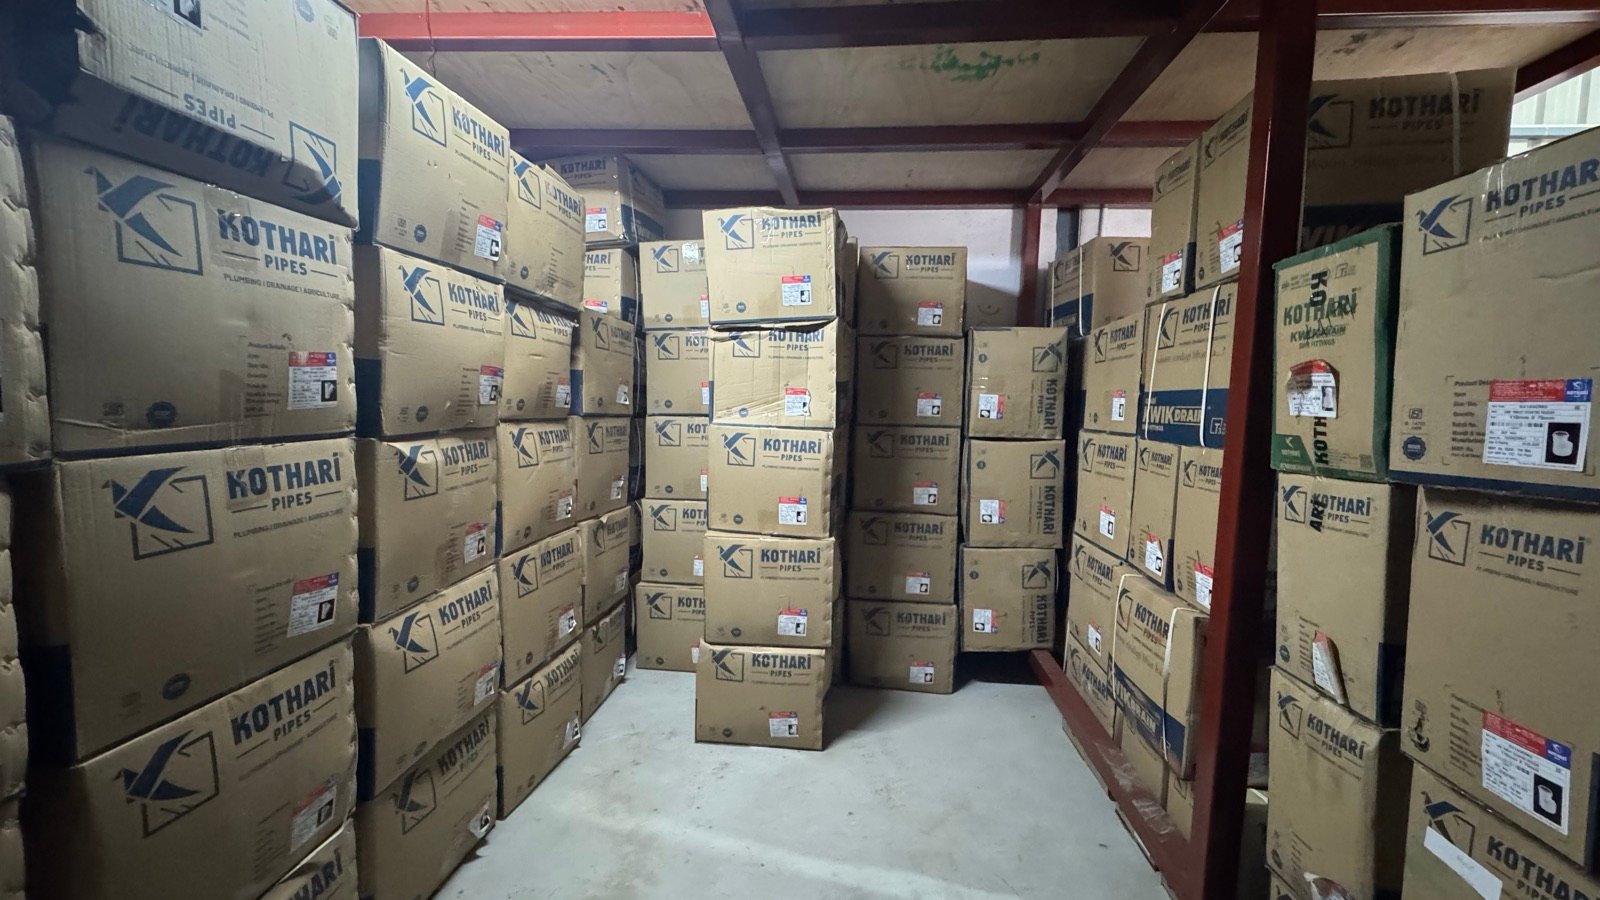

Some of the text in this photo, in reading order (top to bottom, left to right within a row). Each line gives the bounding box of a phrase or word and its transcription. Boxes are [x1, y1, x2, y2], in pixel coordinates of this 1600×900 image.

[183, 93, 236, 129] PIPES
[472, 142, 491, 161] PIPES
[1519, 195, 1566, 218] PIPES
[264, 254, 308, 276] PIPES
[585, 252, 611, 264] HARI
[468, 309, 487, 321] PIPES
[1182, 293, 1232, 325] KOTHRI
[226, 452, 341, 500] KOTHARI
[460, 464, 479, 476] PIPES
[271, 492, 312, 511] PIPES
[1327, 512, 1350, 523] PIPES
[1480, 524, 1585, 564] KOTHARI
[1507, 554, 1545, 571] PIPES
[461, 611, 481, 628] PIPES
[231, 659, 336, 746] KOTHARI
[273, 709, 312, 741] PIPES
[1487, 835, 1600, 900] KOTHA
